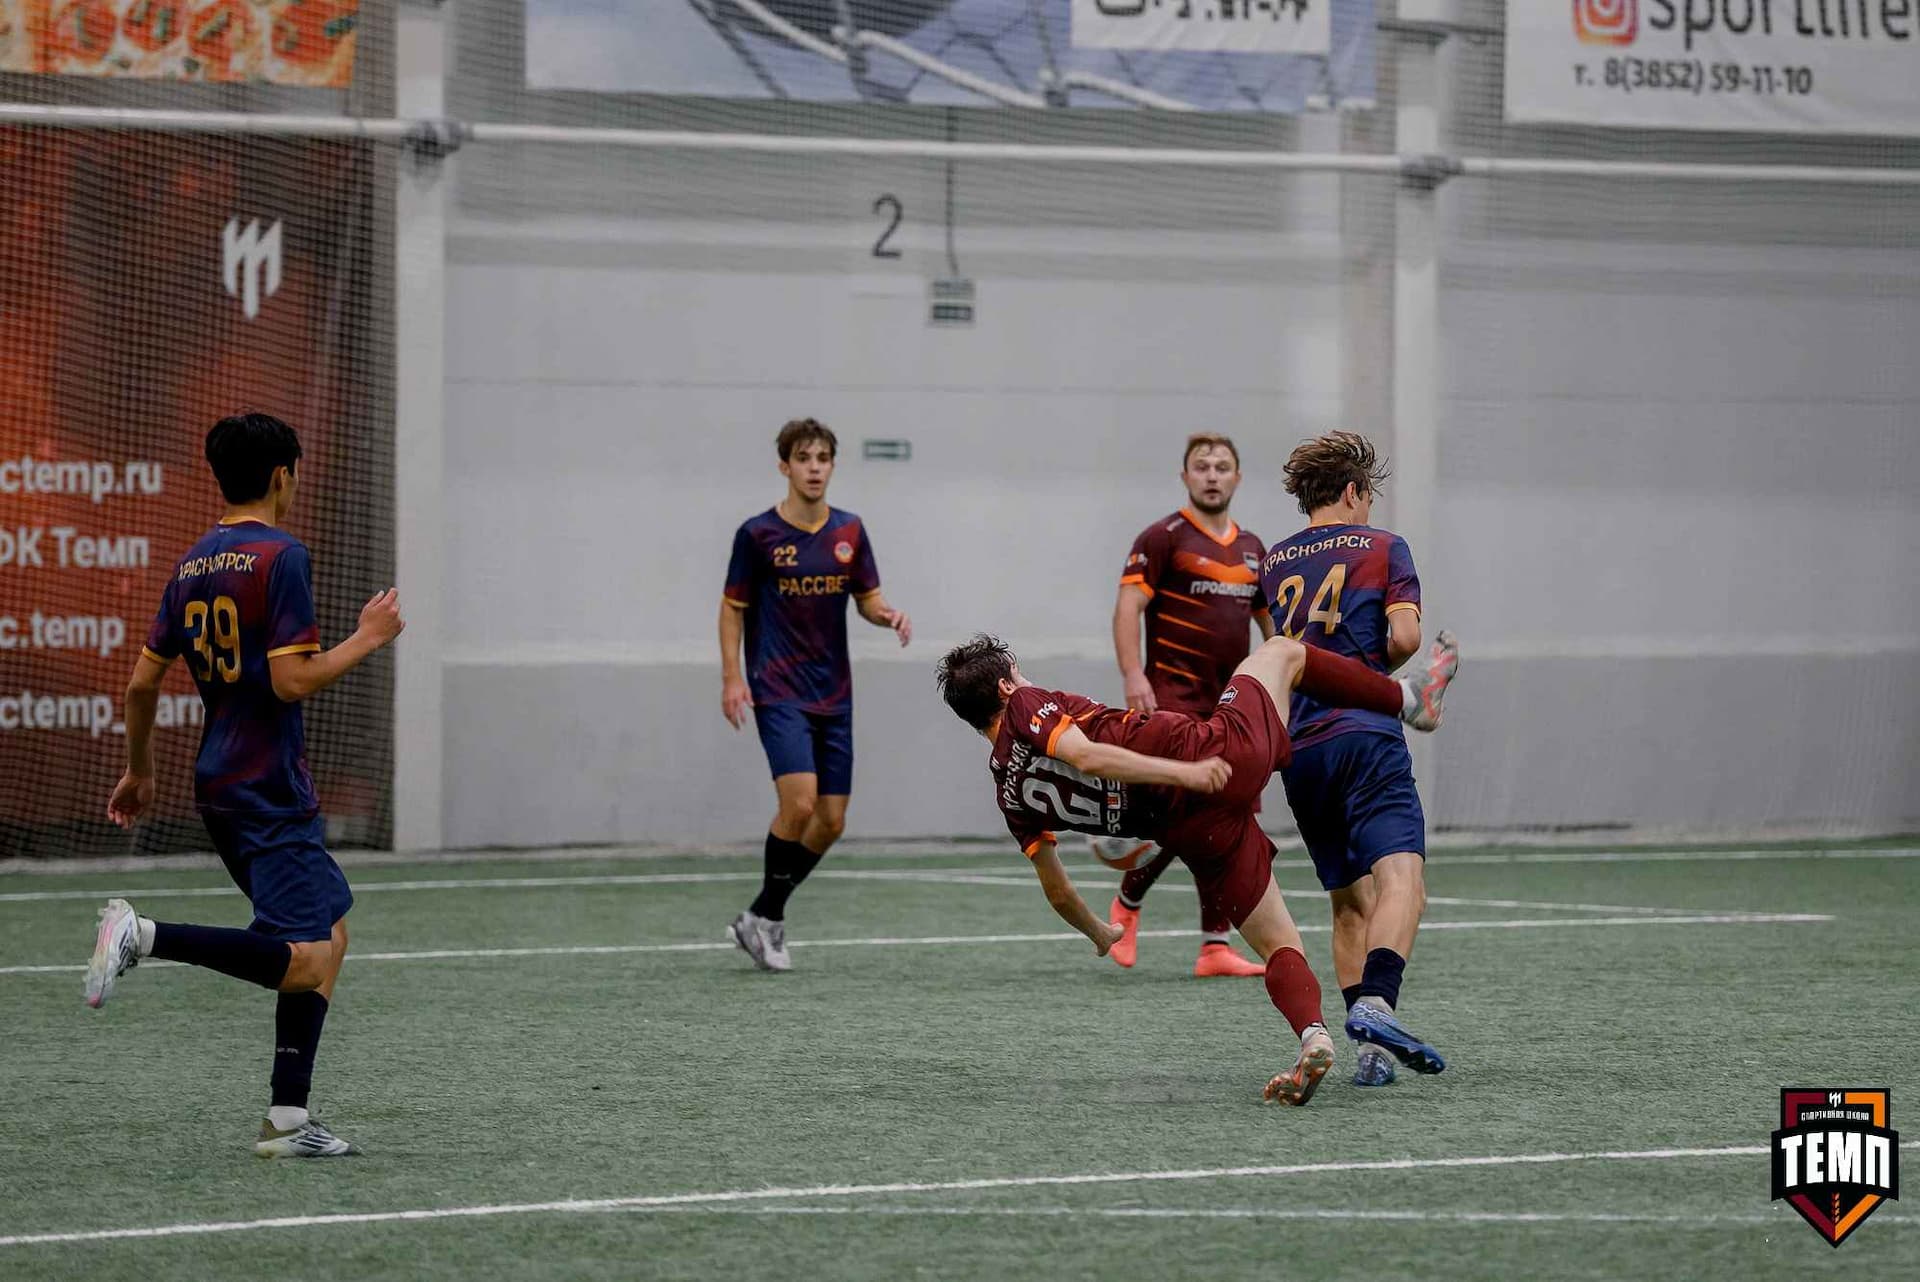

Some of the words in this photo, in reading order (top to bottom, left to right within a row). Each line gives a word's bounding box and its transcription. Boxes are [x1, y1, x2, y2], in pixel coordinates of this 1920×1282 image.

[872, 194, 904, 259] 2
[51, 526, 149, 568] Темп
[773, 545, 799, 567] 22
[1263, 535, 1373, 576] КРАСНОЯРСК
[778, 575, 850, 596] РАССВЕ
[1276, 563, 1347, 641] 24
[184, 595, 242, 684] 39
